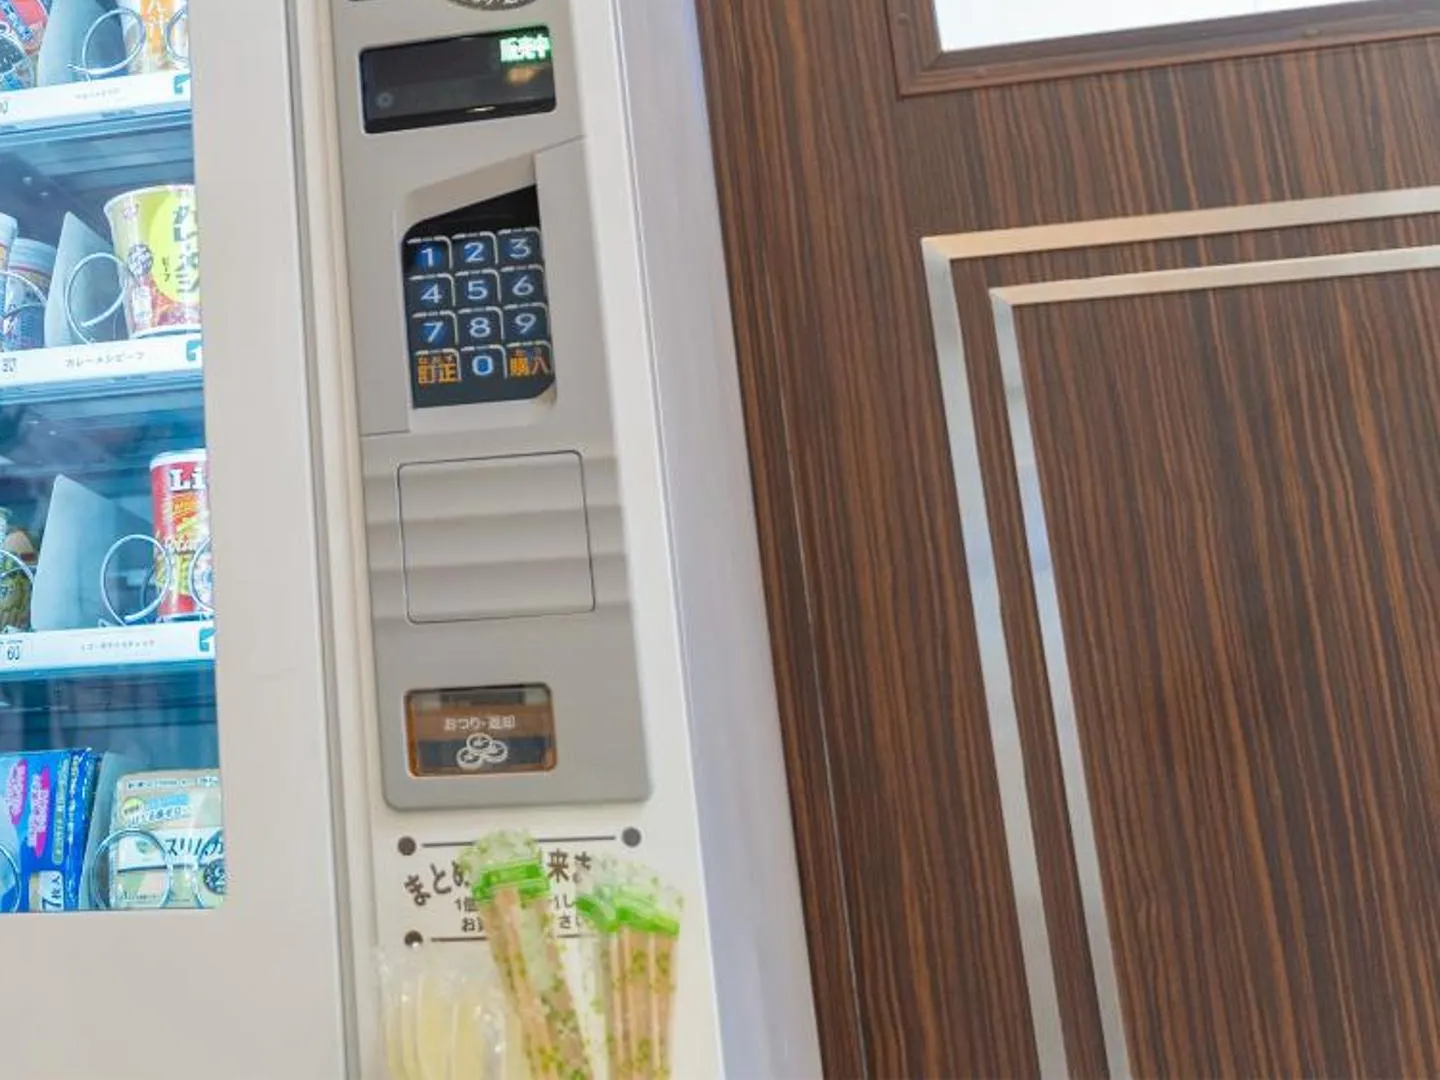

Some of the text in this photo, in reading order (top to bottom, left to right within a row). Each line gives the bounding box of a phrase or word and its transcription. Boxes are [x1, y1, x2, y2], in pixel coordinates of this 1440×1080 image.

[422, 238, 531, 268] 1 2 3
[420, 275, 534, 304] 4 5 6
[423, 313, 536, 343] 7 8 9
[472, 355, 493, 376] 0
